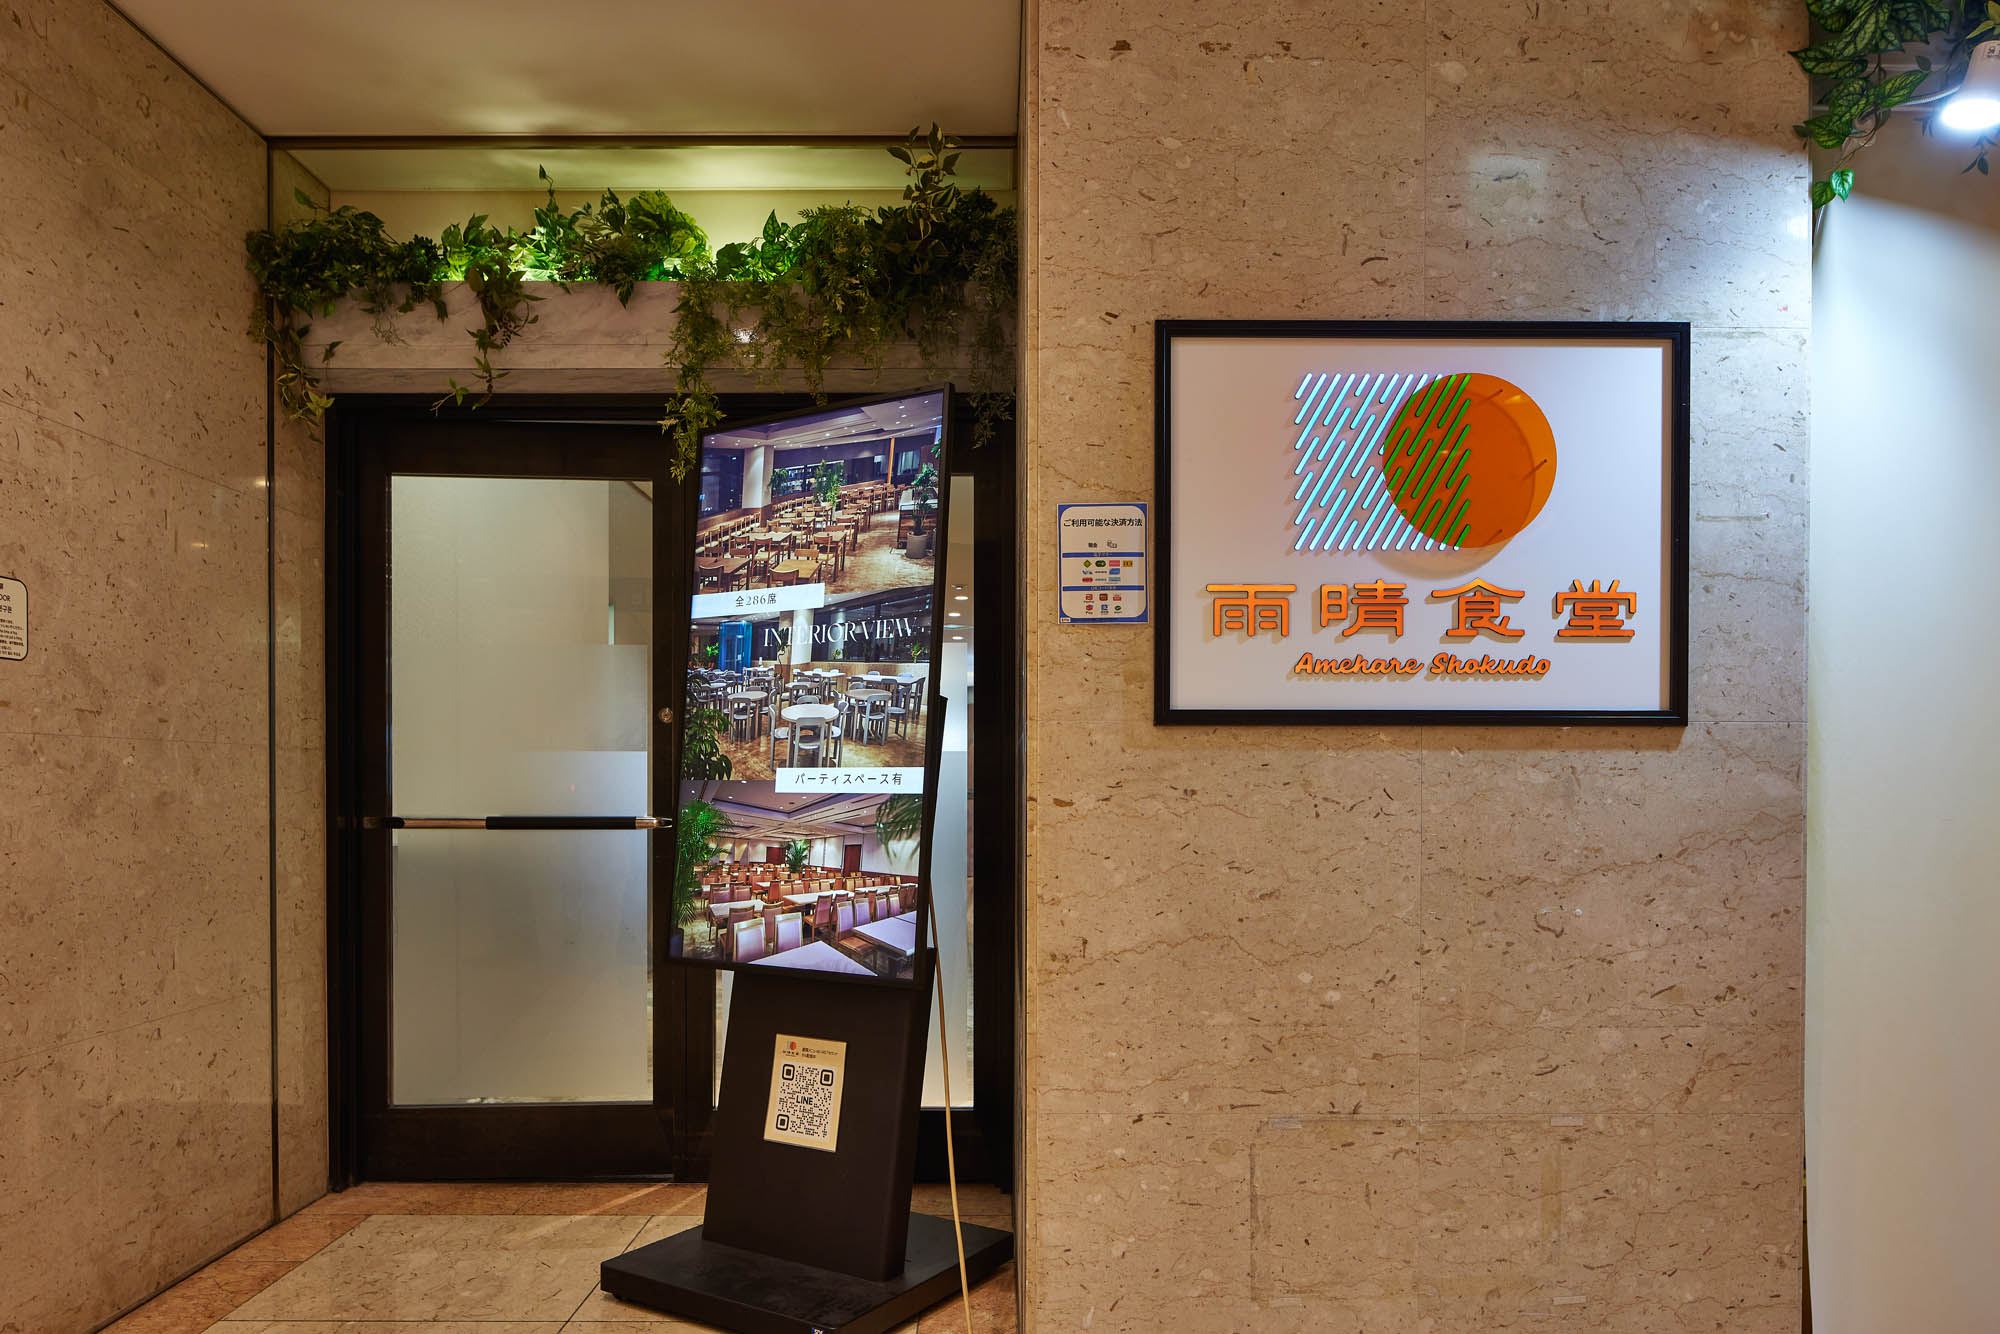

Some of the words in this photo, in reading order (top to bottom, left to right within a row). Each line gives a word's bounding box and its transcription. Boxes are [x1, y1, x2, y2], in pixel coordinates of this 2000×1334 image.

[1063, 518, 1143, 528] ご利用可能な決済方法
[735, 592, 777, 608] 全286席
[1206, 578, 1637, 637] 雨晴食堂
[861, 617, 917, 640] VIEW
[1294, 652, 1425, 675] Amehare
[1431, 652, 1551, 675] Shokudo
[795, 772, 903, 786] パーティスペース有
[796, 1095, 814, 1106] LINE
